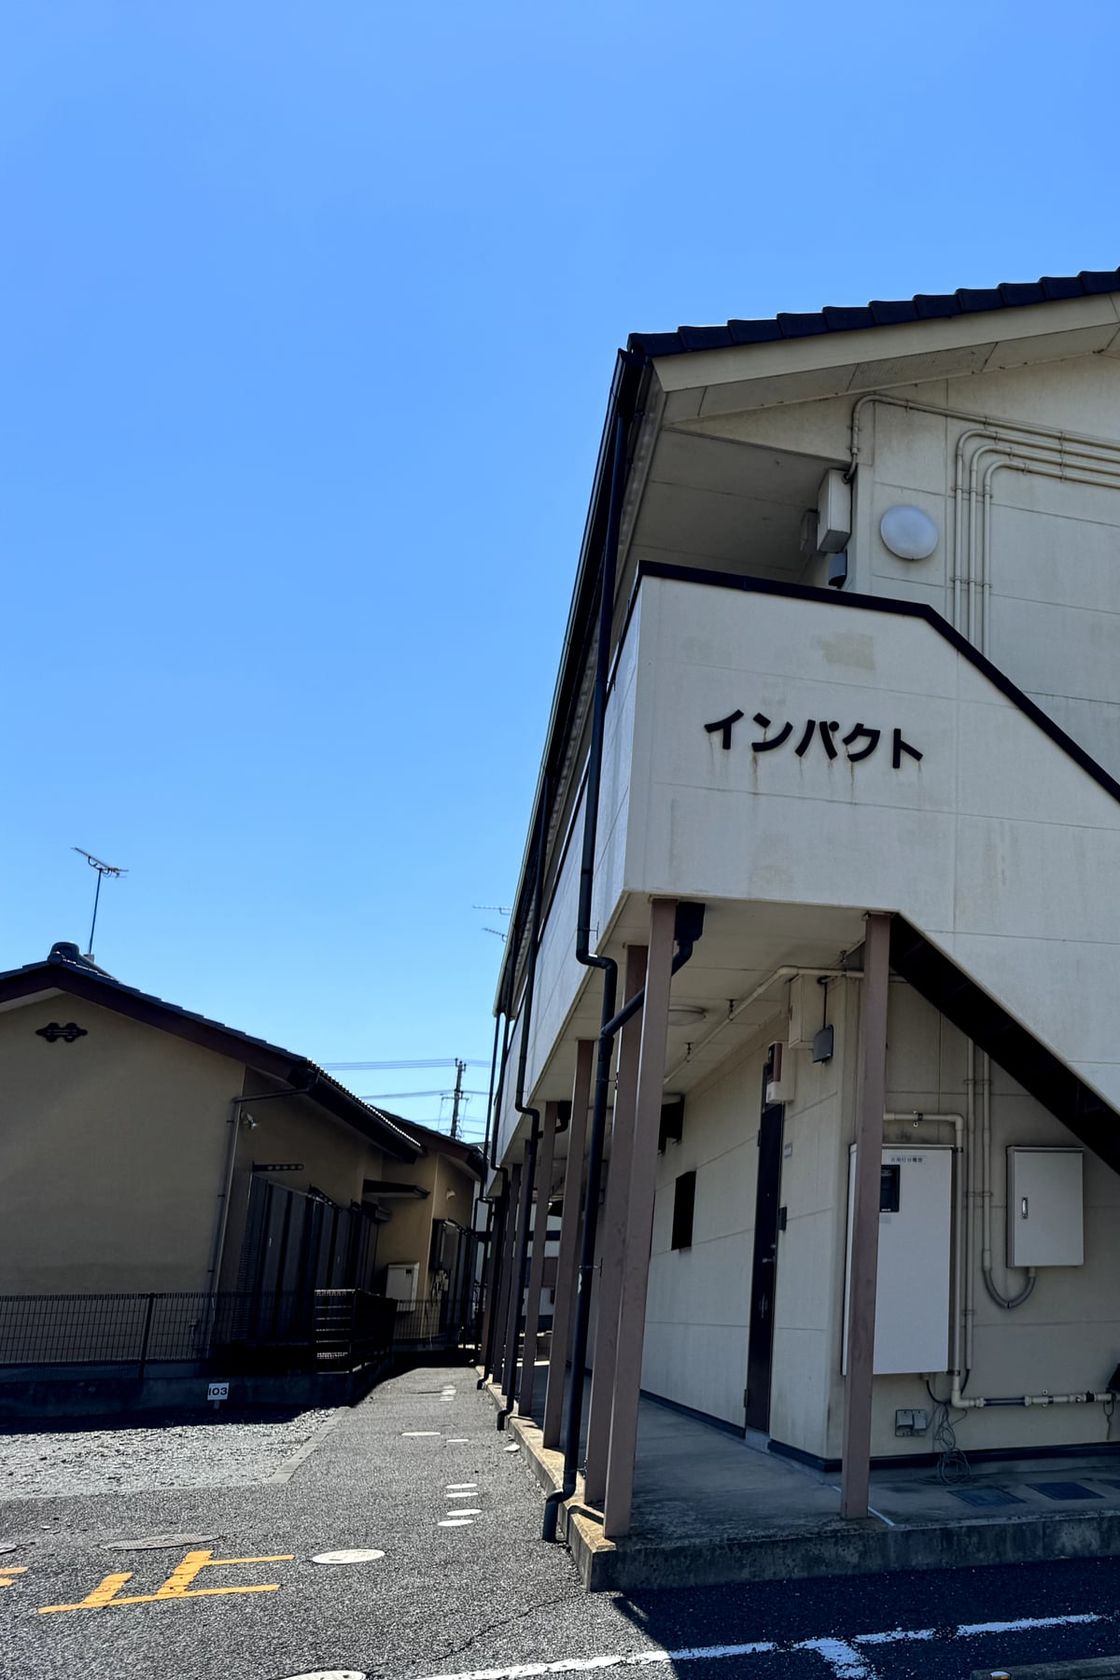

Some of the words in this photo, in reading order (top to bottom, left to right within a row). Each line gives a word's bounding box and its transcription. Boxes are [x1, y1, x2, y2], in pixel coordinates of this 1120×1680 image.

[704, 709, 924, 769] インパクト
[208, 1387, 228, 1396] 103
[0, 1549, 295, 1614] 止
